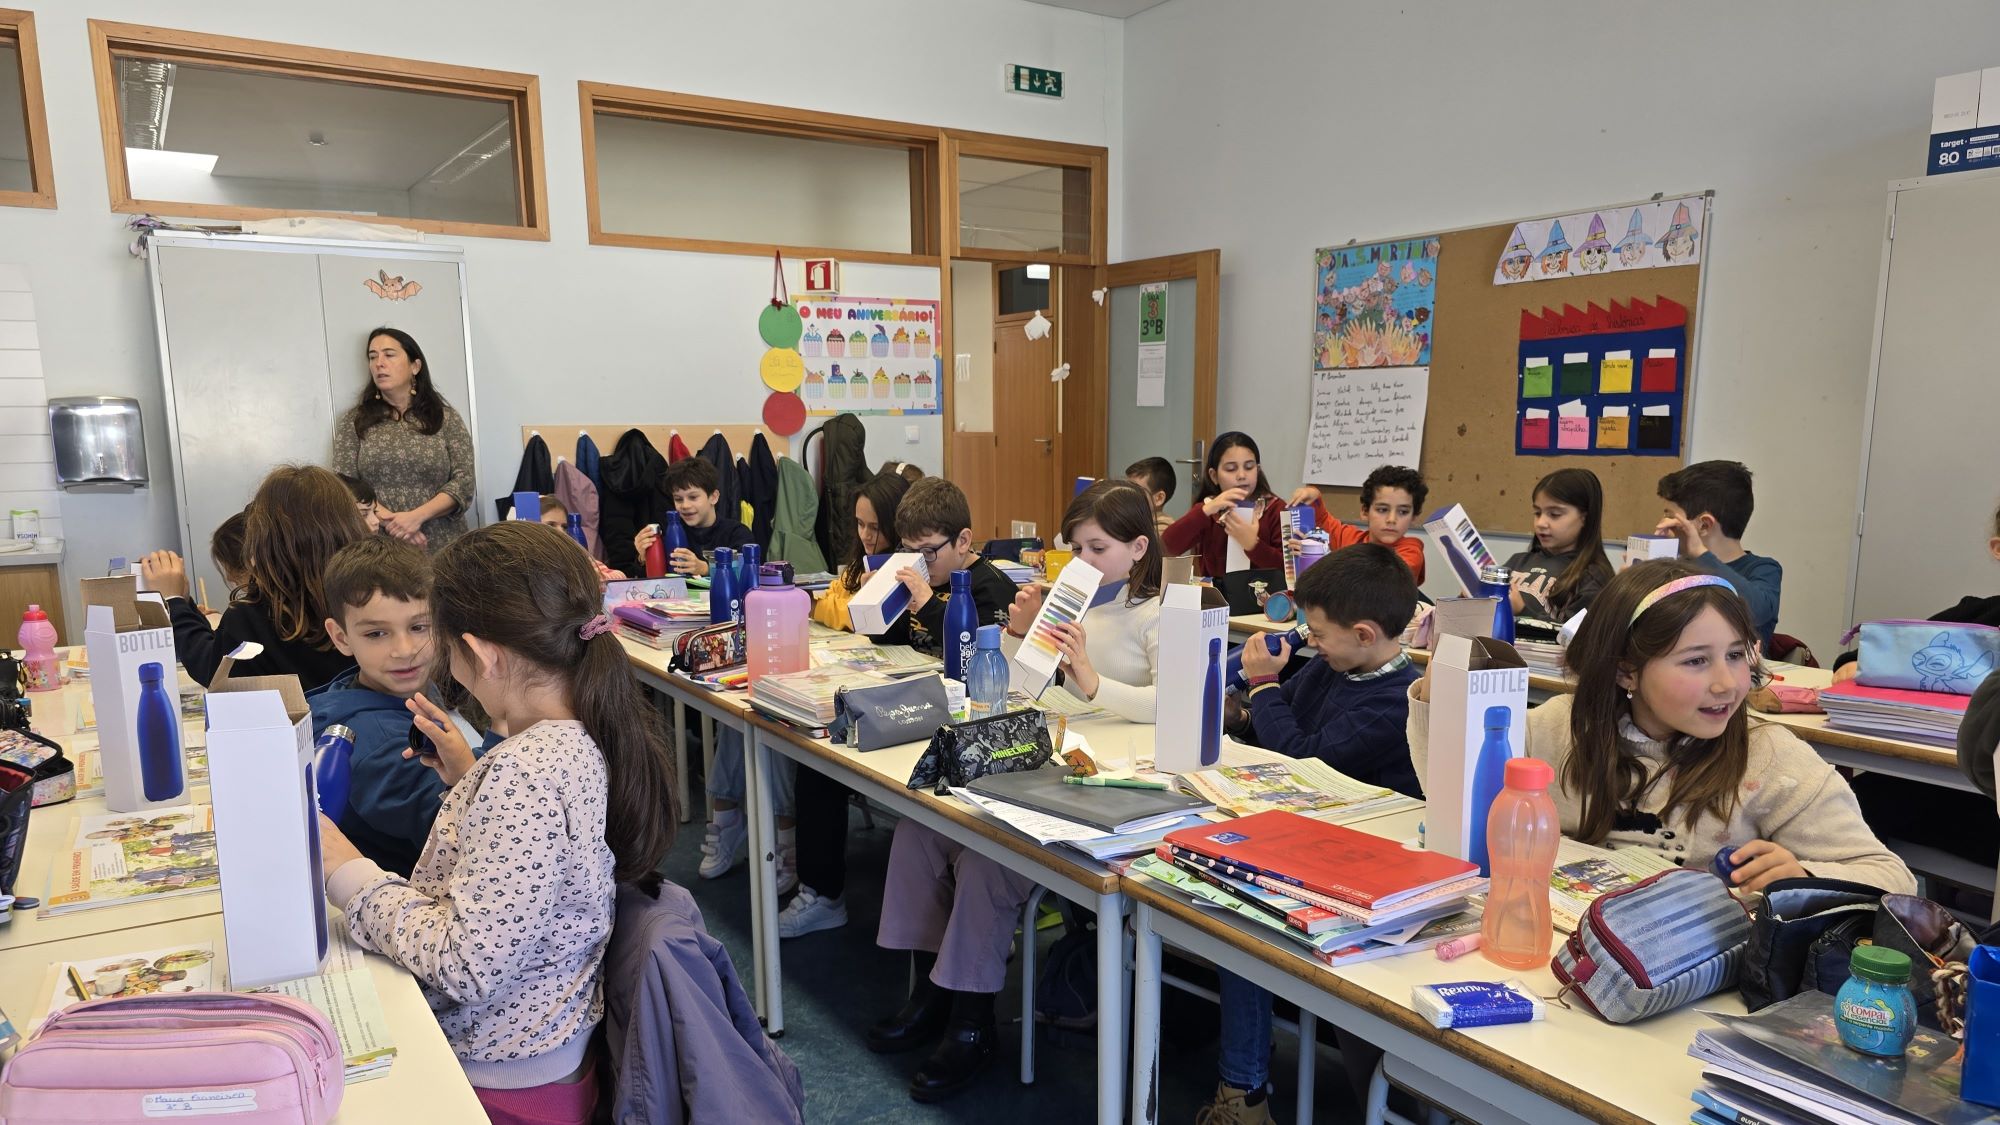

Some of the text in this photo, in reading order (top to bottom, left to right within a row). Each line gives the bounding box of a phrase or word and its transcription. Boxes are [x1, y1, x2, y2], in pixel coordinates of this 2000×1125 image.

[1941, 139, 1963, 147] target
[1939, 151, 1959, 165] 80
[800, 306, 933, 323] O MEU ANIVERSÁRIO!
[1147, 300, 1159, 319] 3
[1202, 607, 1229, 628] BOTTLE
[118, 629, 173, 654] BOTTLE
[1469, 669, 1527, 695] BOTTLE
[991, 742, 1039, 760] MINECRAFT
